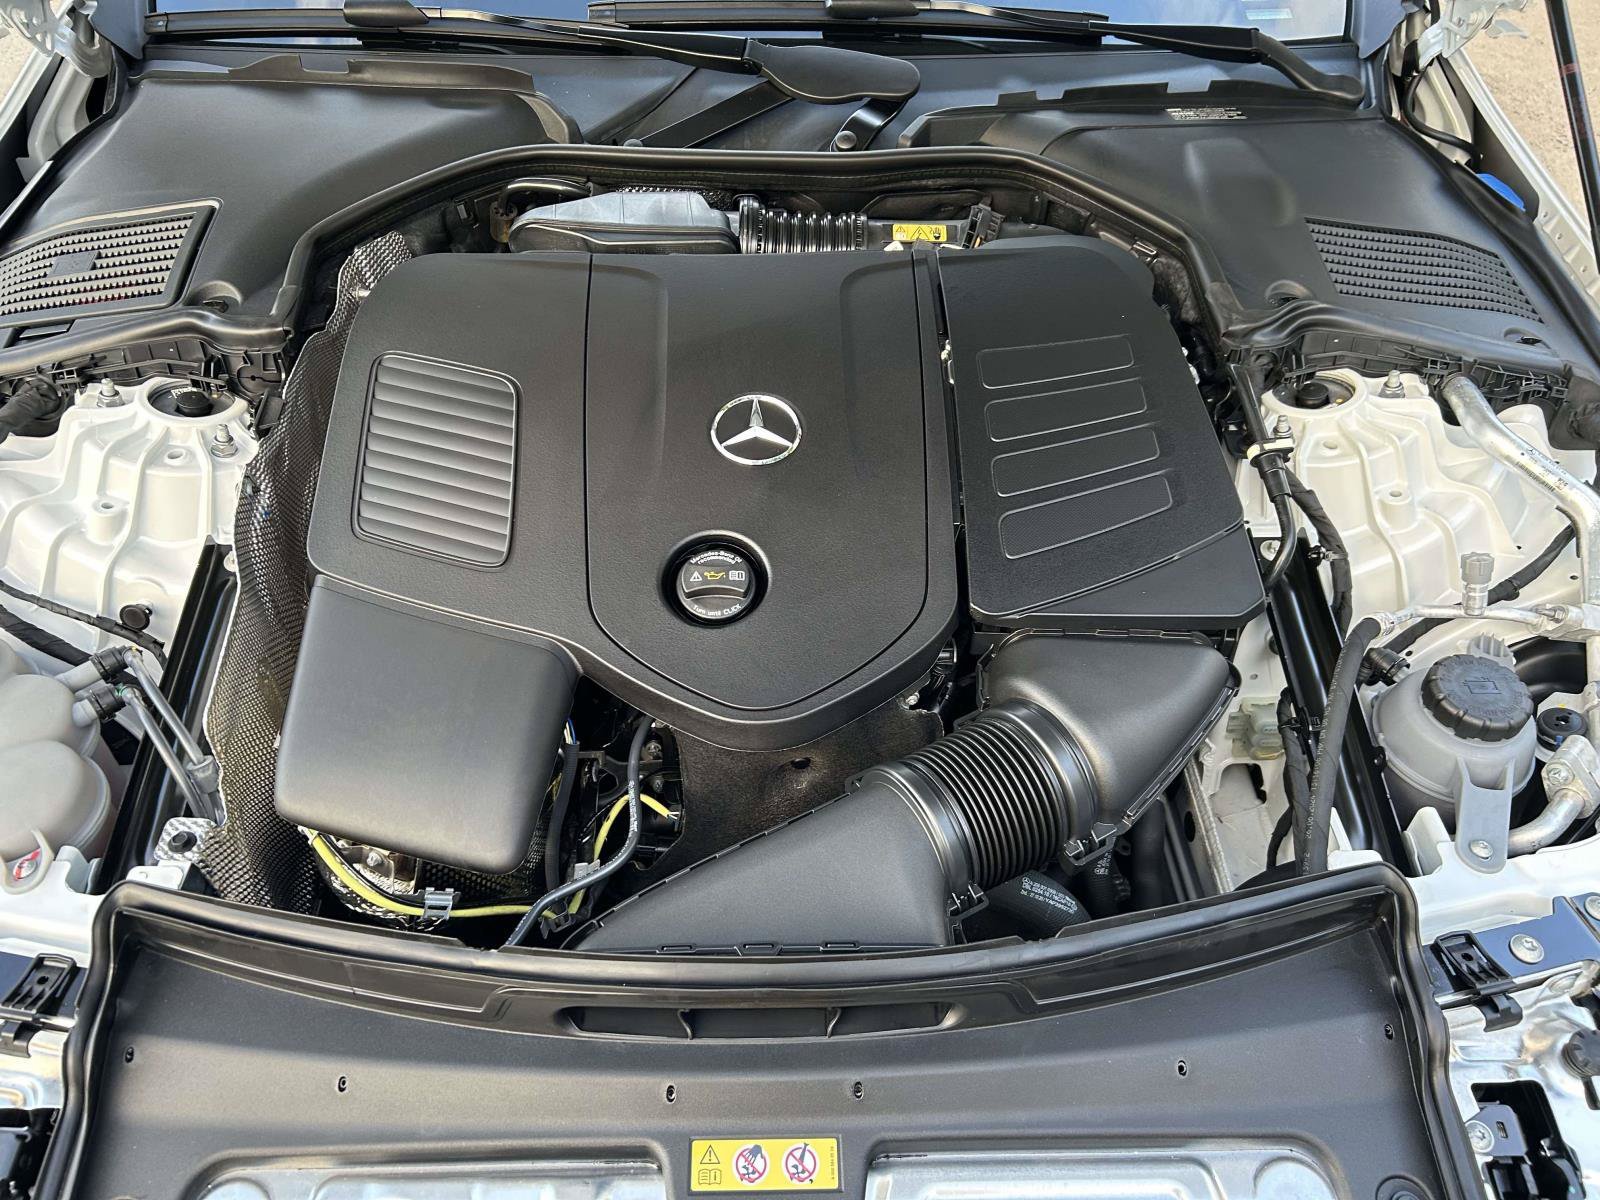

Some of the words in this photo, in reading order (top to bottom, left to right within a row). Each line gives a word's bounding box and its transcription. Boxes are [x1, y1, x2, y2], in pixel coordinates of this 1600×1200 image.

[690, 551, 735, 564] Mercedes-Benz
[693, 604, 706, 615] Turn
[723, 603, 742, 615] CLICK
